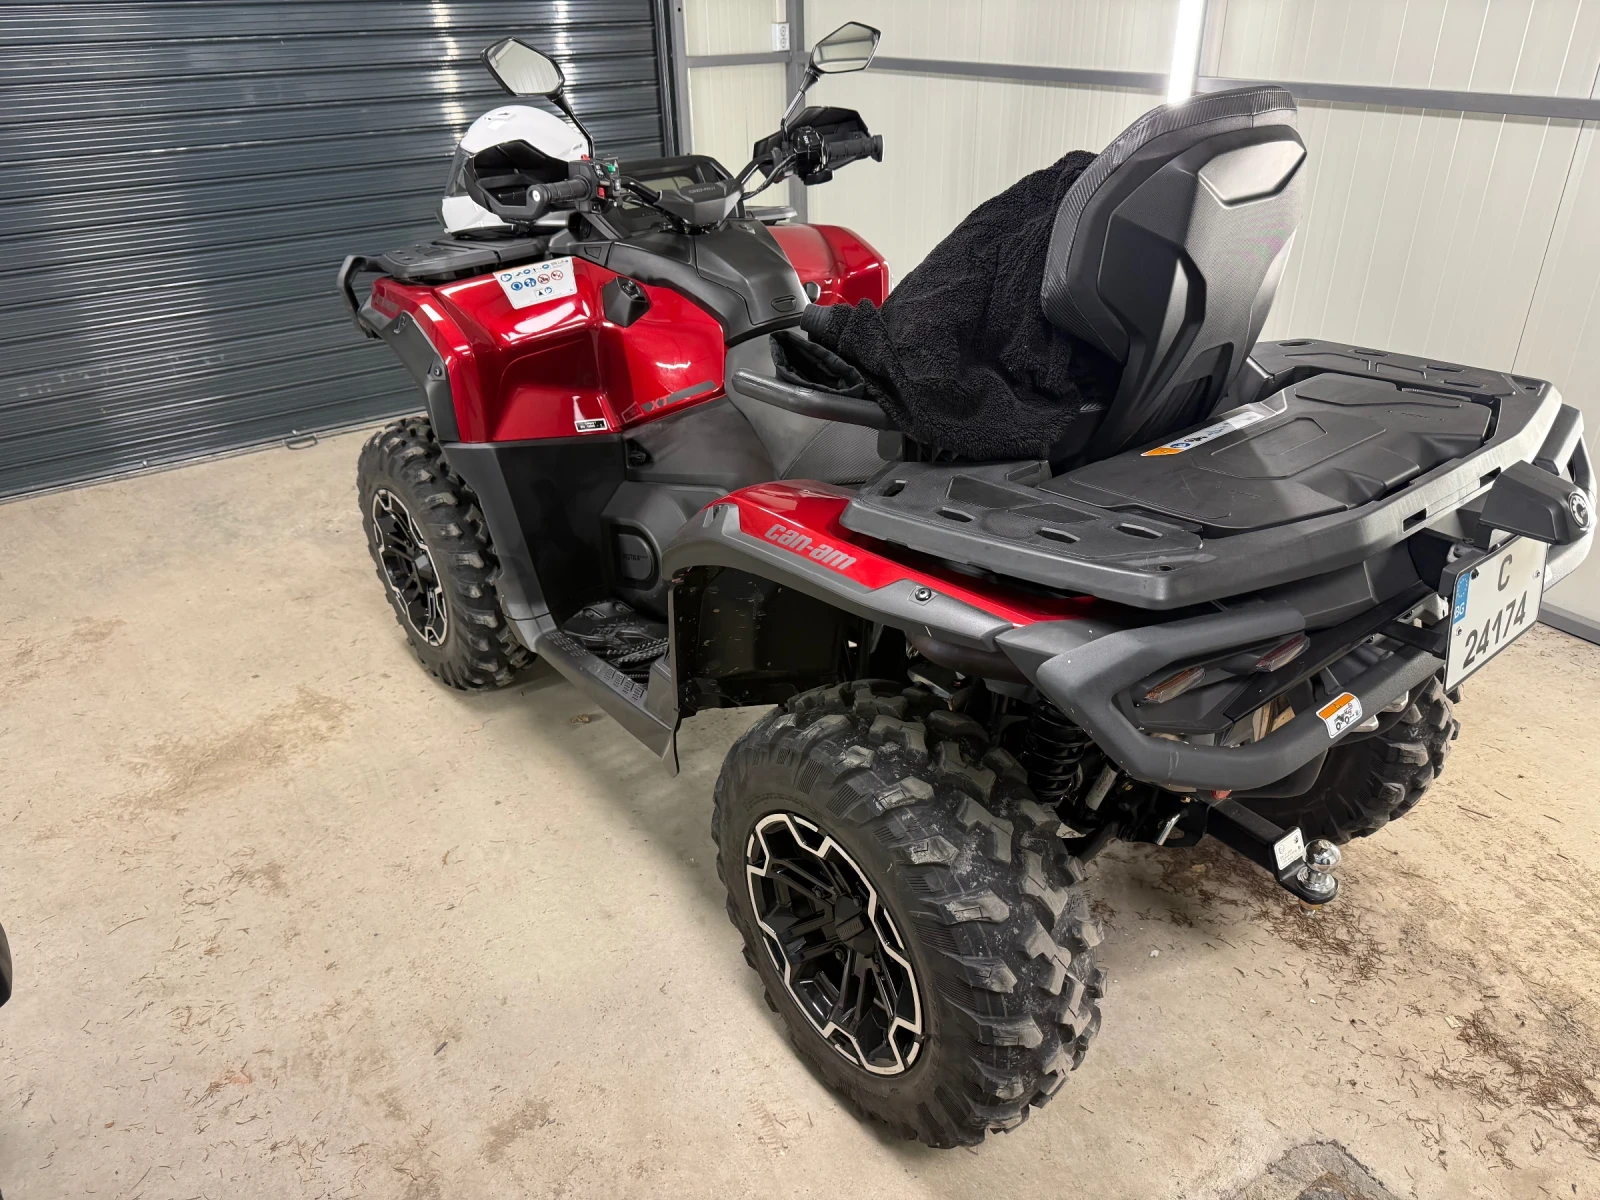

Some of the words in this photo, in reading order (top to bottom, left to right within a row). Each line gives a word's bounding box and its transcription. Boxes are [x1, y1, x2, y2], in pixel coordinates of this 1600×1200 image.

[650, 394, 671, 411] XT
[764, 523, 857, 570] can-am
[1497, 553, 1513, 592] C
[1454, 601, 1465, 618] BG
[1462, 589, 1528, 670] 24174
